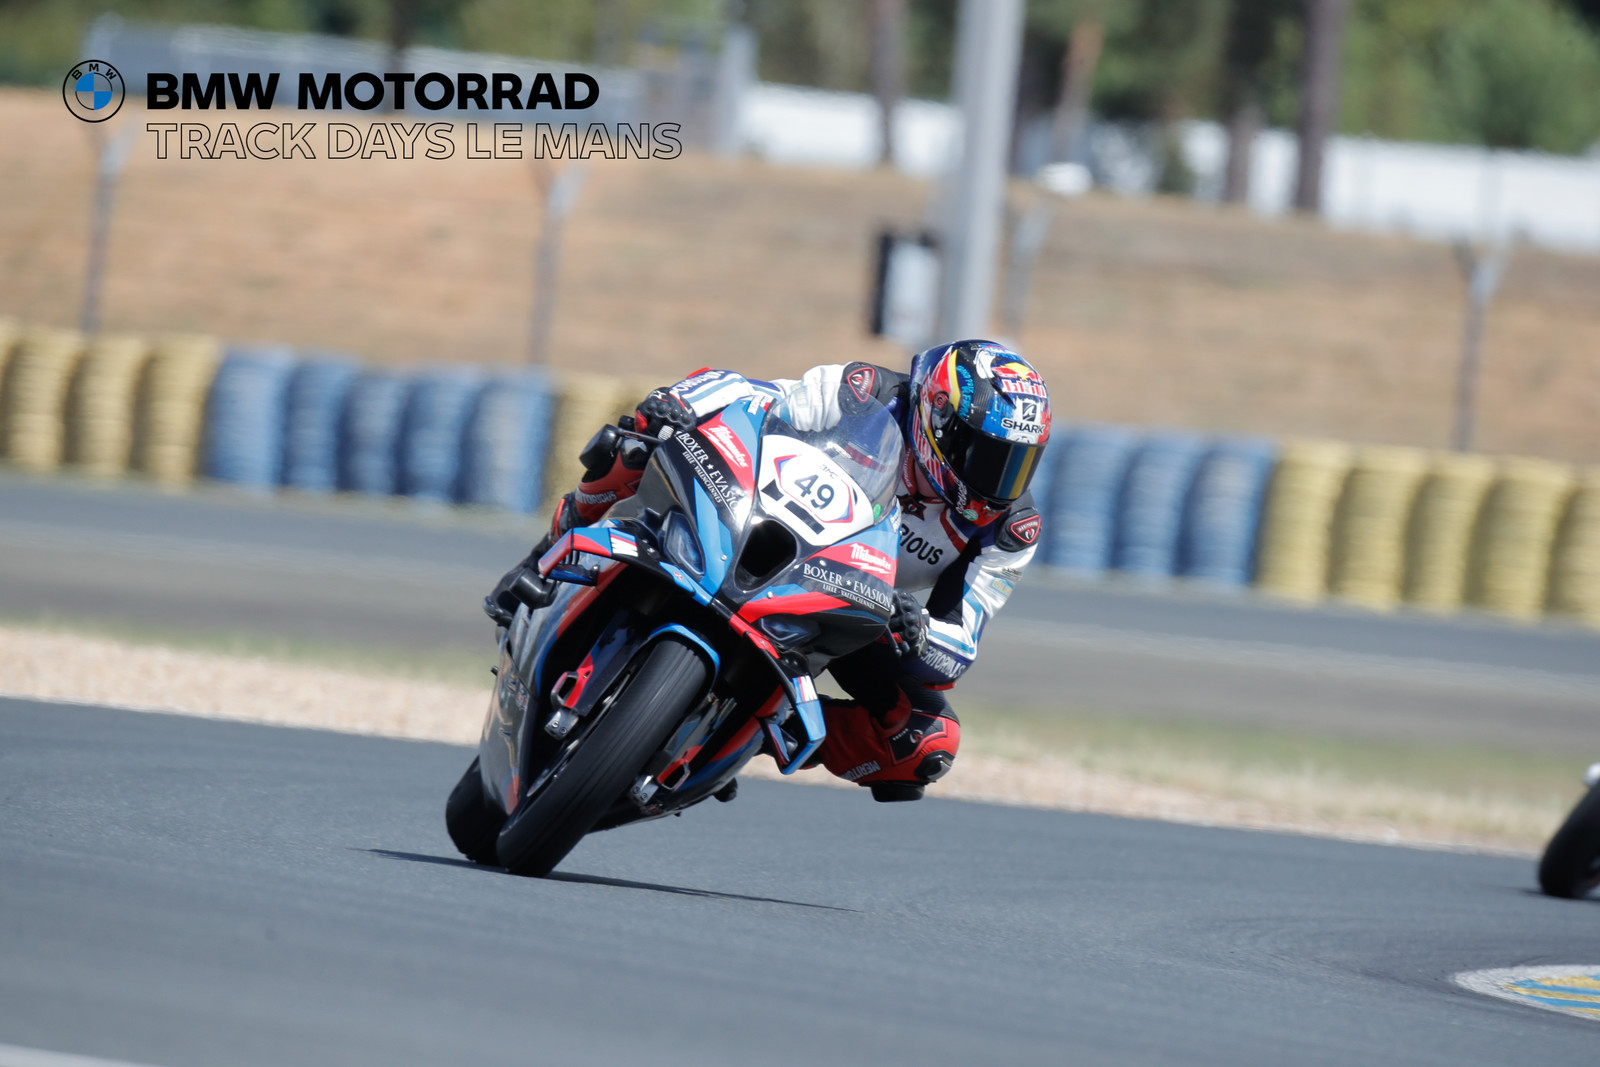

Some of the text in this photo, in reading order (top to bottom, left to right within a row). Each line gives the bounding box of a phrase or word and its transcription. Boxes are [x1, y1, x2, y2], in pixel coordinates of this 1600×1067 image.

[1002, 417, 1045, 434] SHARK
[682, 451, 695, 466] LILLE
[708, 425, 750, 468] Milwaukee
[679, 432, 738, 511] BOXER EVASIO
[794, 474, 835, 510] 49
[849, 543, 892, 570] Milwaukee
[803, 563, 892, 609] BOXER EVASION
[822, 583, 876, 610] LILLE VALENCIENNES
